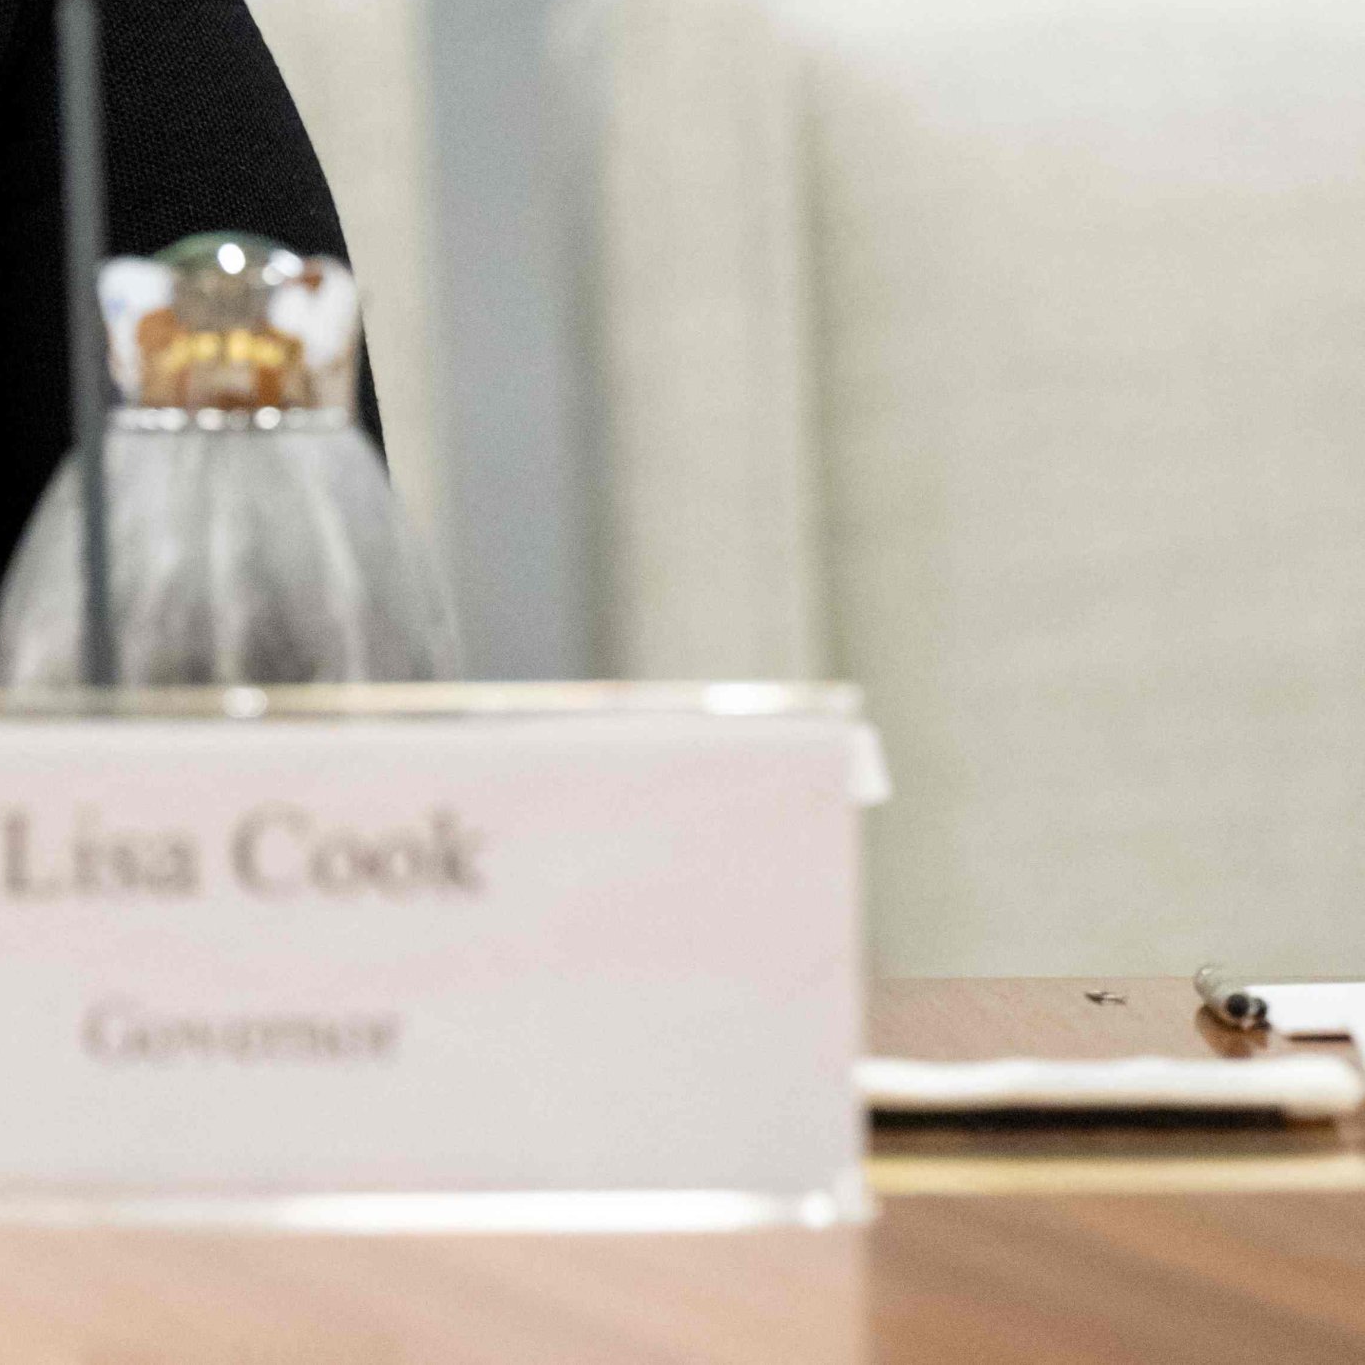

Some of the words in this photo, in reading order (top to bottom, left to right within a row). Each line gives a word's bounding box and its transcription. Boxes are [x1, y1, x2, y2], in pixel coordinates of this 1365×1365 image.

[0, 803, 202, 901] Lisa
[229, 804, 487, 901] Cook
[80, 999, 401, 1067] Governor
